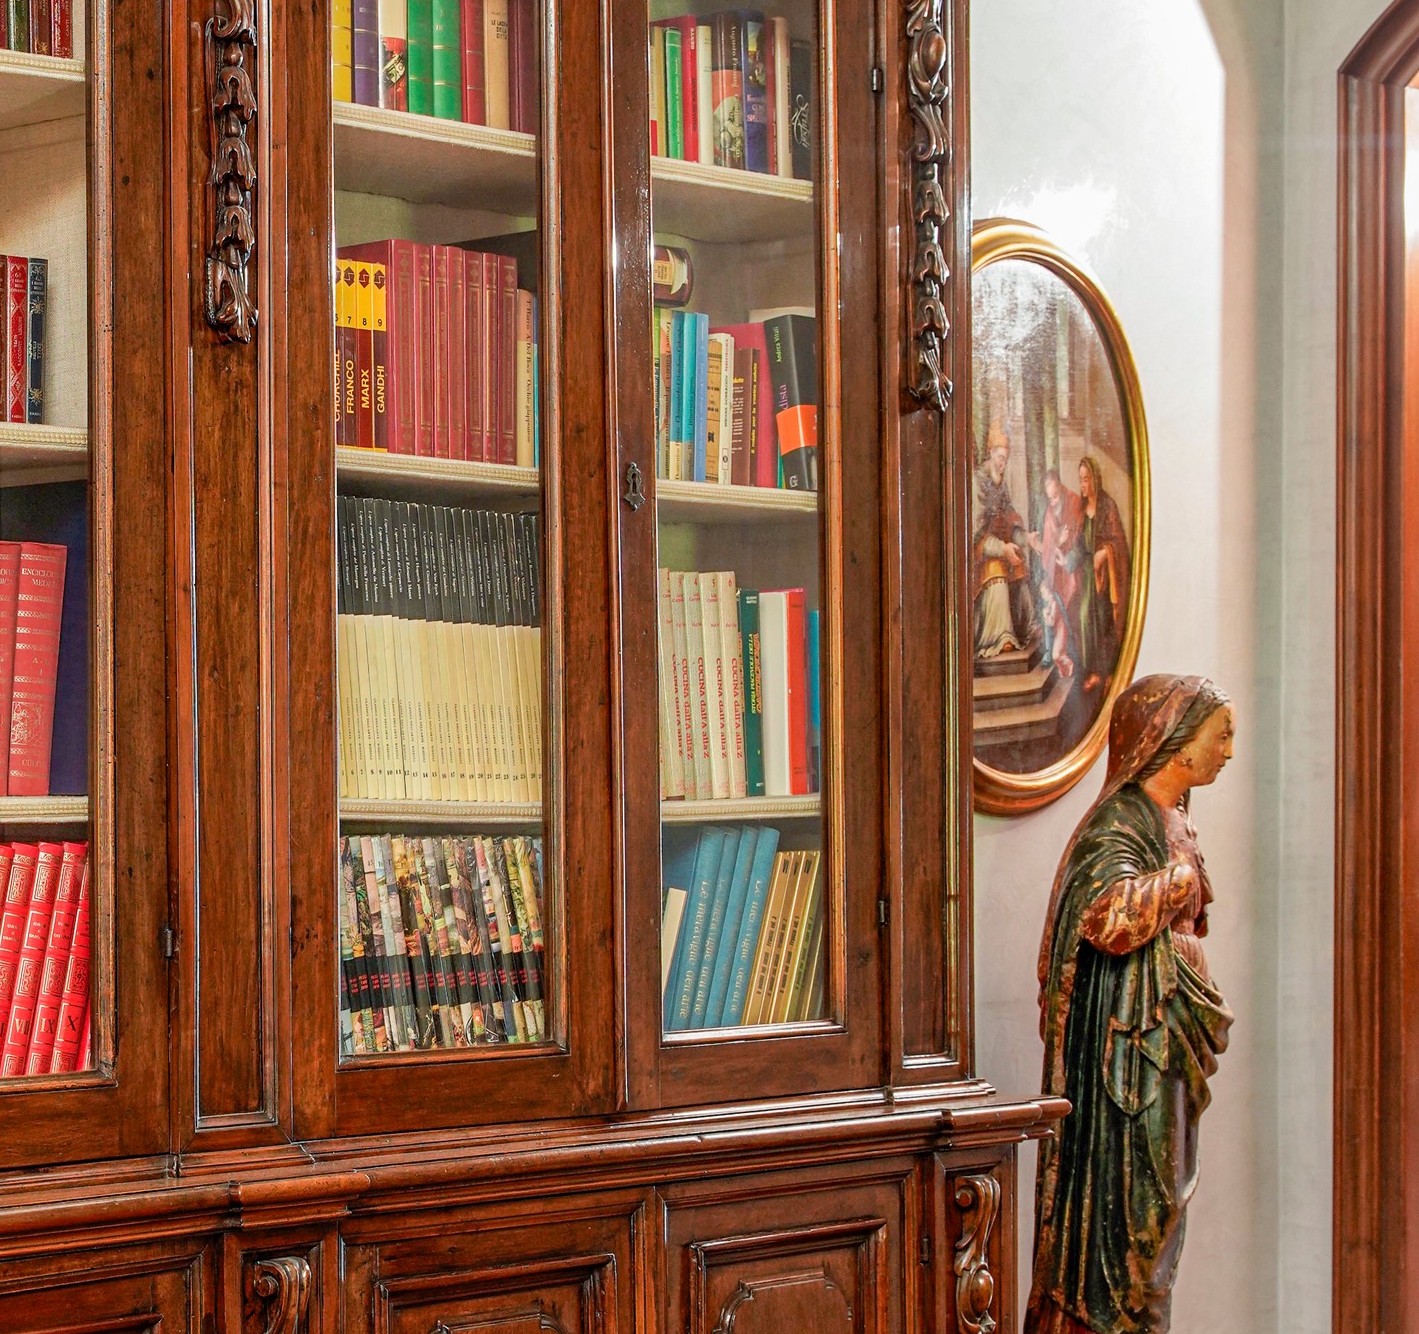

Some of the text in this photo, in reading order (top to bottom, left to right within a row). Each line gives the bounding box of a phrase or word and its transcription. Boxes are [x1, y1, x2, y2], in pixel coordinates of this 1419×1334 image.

[347, 316, 352, 324] 7
[362, 317, 367, 326] 8
[377, 318, 383, 327] 9
[774, 342, 782, 363] Andrea
[346, 359, 355, 414] FRANCO
[361, 368, 369, 409] MARX
[377, 365, 385, 414] GANDHI
[789, 475, 798, 488] G
[728, 579, 733, 587] 6
[681, 658, 689, 698] CUCINA
[698, 657, 706, 698] CUCINA
[731, 658, 739, 698] CUCINA
[700, 699, 708, 729] dall'A
[733, 700, 742, 729] dall'A
[703, 751, 710, 759] Z
[736, 751, 743, 759] Z
[39, 1017, 55, 1034] IX
[66, 1015, 78, 1032] X
